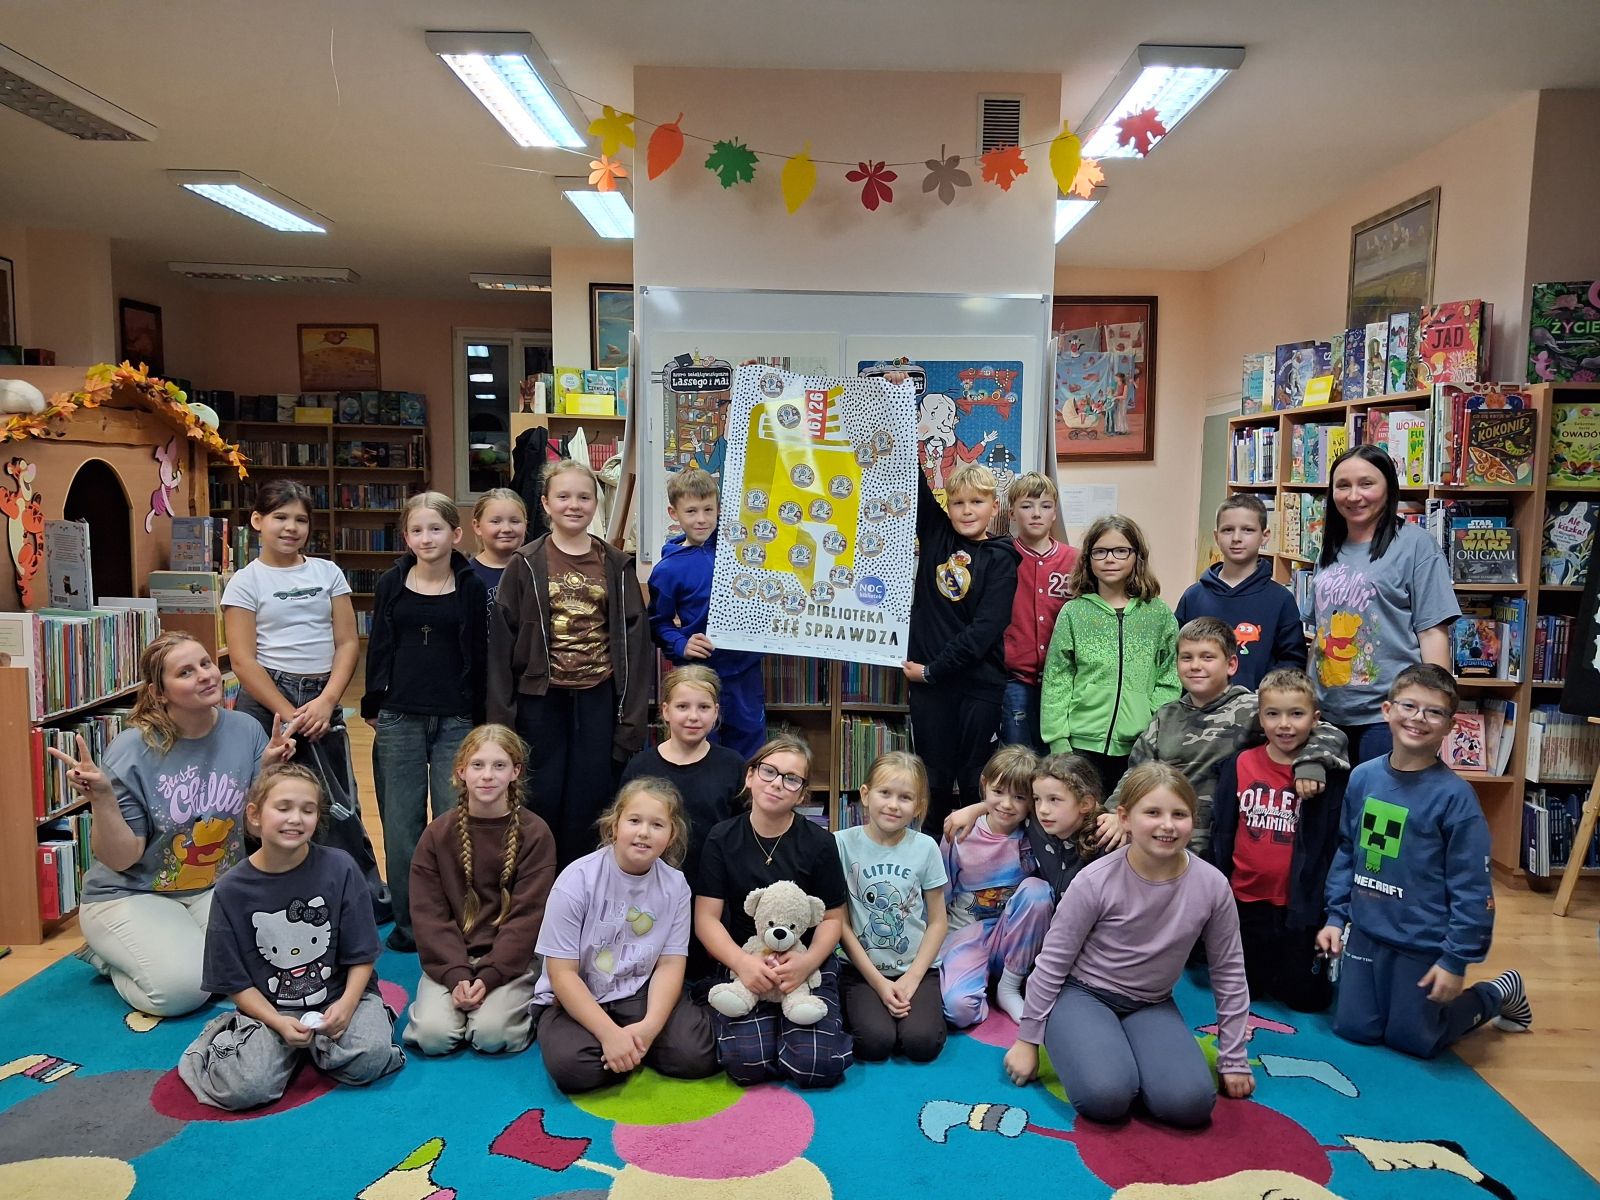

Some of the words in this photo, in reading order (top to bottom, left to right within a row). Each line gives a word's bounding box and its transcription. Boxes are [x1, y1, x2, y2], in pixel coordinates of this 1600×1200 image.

[1551, 319, 1600, 335] ŻYCIE
[1432, 326, 1464, 349] JAD
[1477, 417, 1530, 442] KOKONIE?
[1562, 430, 1600, 438] OWADÓ
[1462, 530, 1512, 540] STAR
[1461, 540, 1512, 550] WARS
[1456, 550, 1516, 561] ORIGAMI
[859, 583, 883, 594] NOC
[807, 603, 885, 625] BIBLIOTEKA
[771, 618, 800, 638] SIĘ
[804, 621, 899, 647] SPRAWDZA
[157, 764, 199, 799] just
[862, 863, 912, 880] LITTLE
